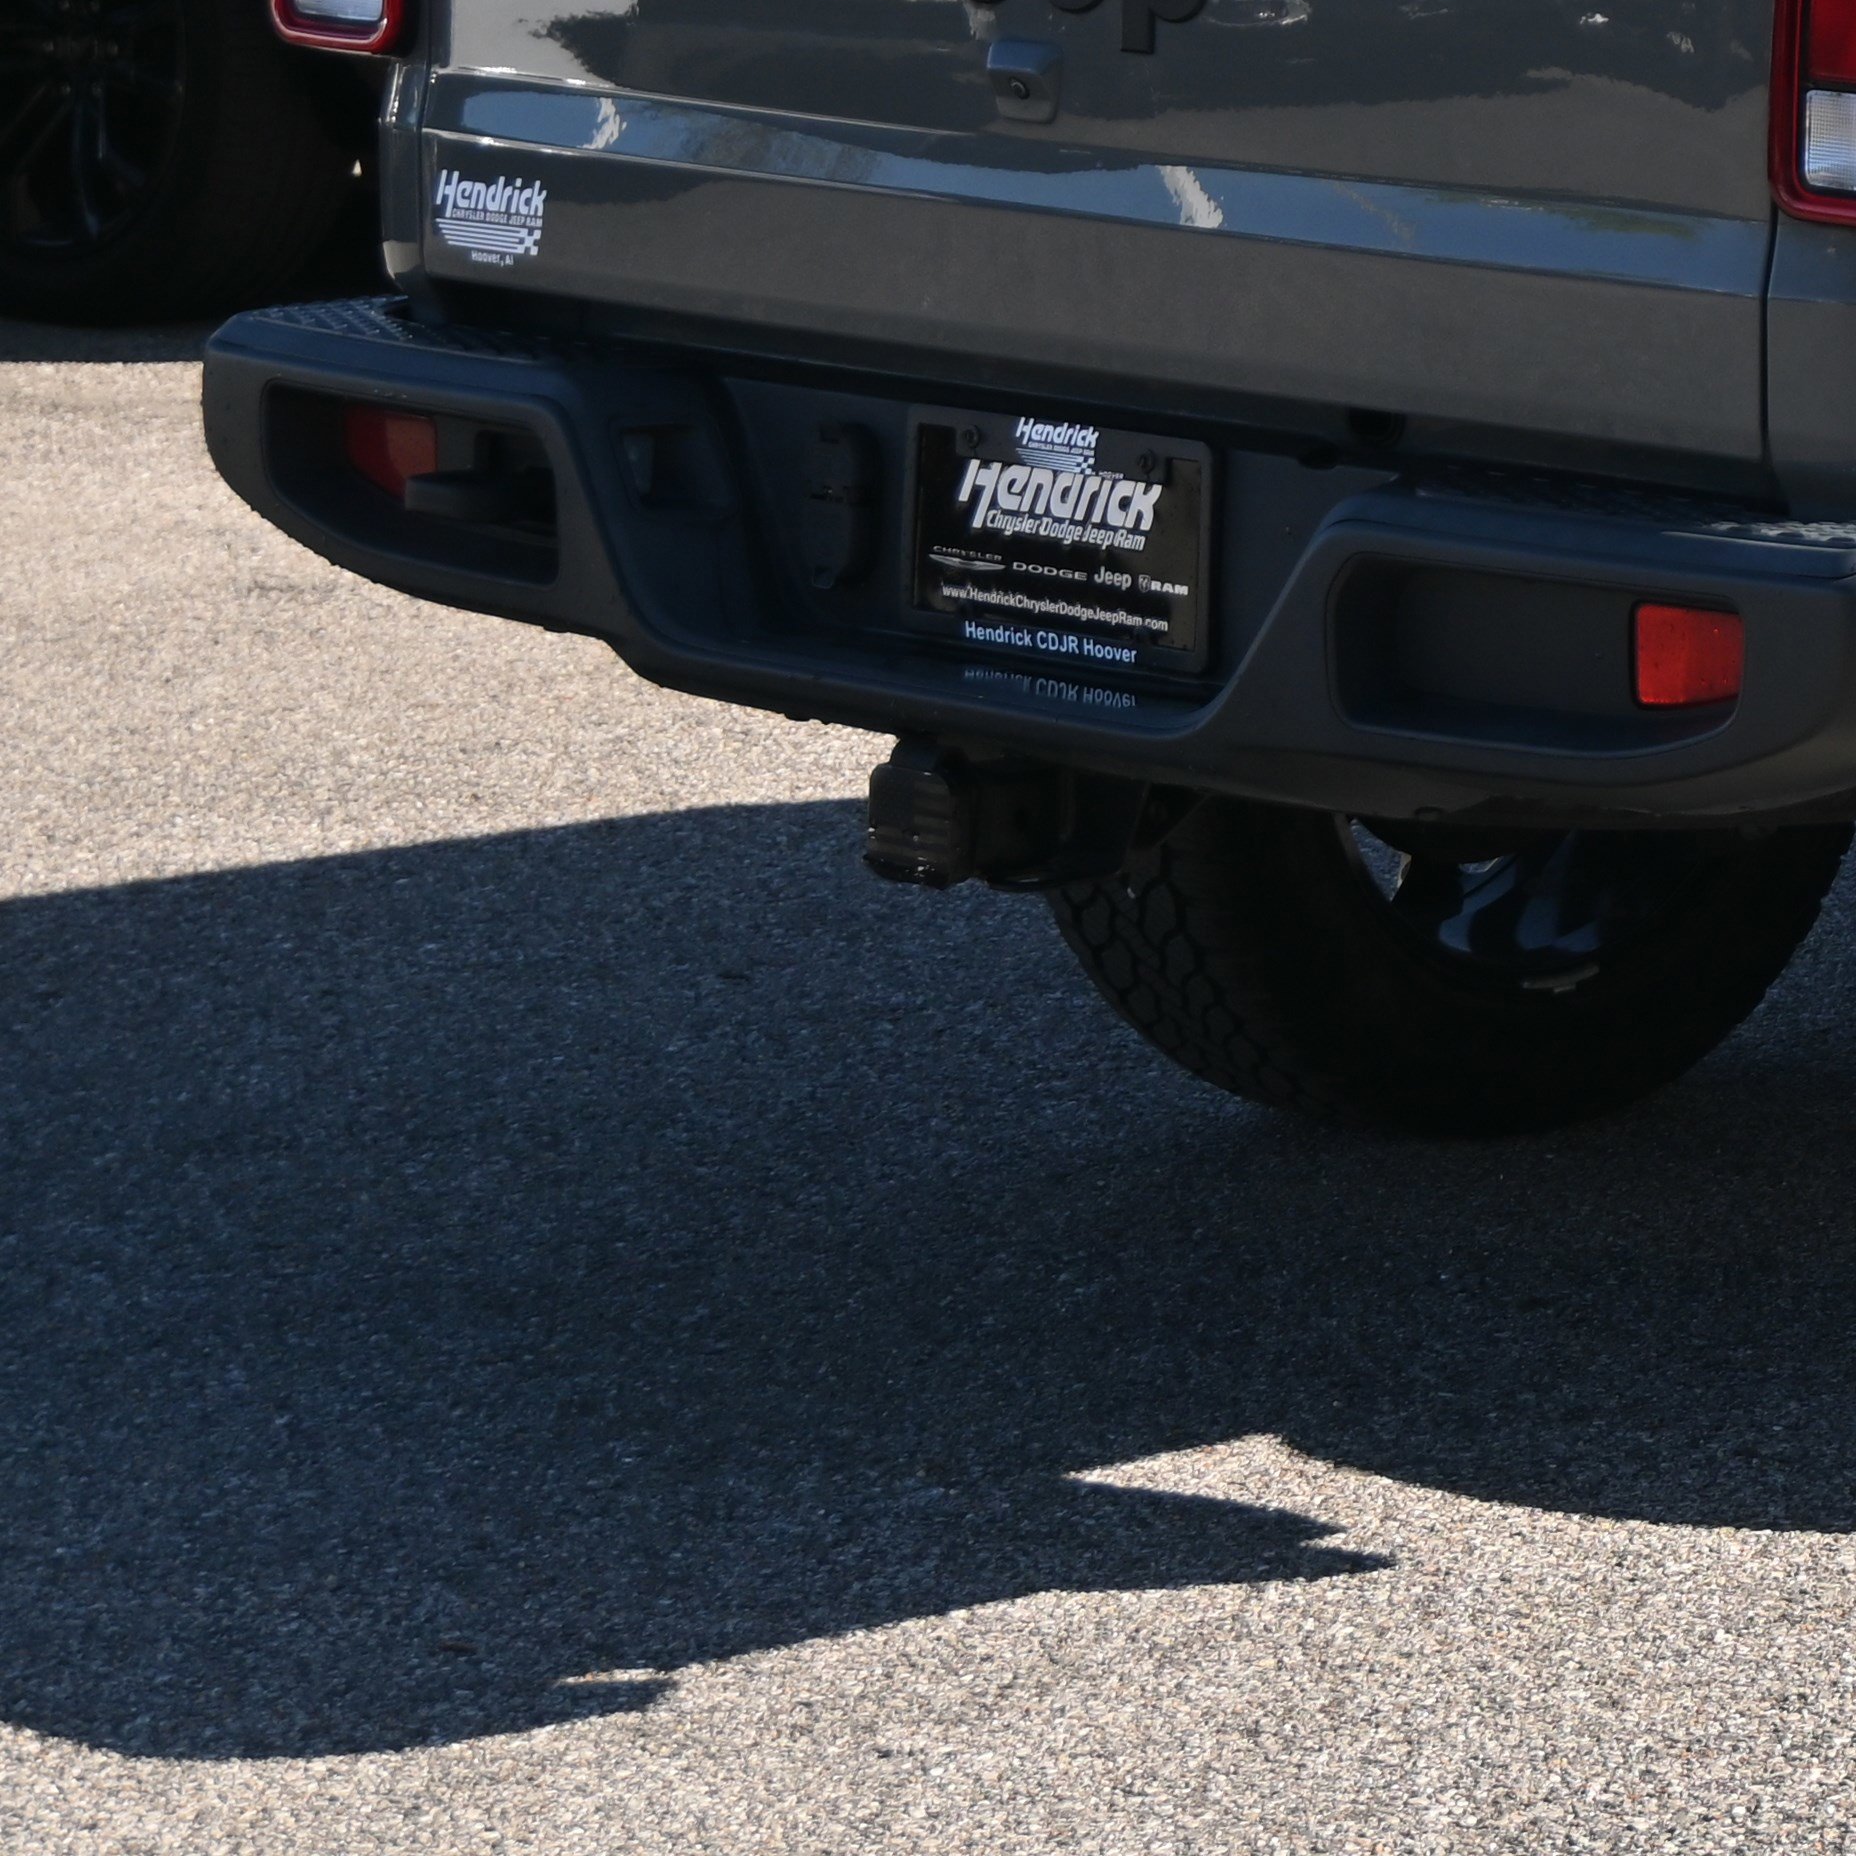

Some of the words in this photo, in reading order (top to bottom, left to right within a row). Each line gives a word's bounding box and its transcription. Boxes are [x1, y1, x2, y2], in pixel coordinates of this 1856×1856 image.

[436, 169, 547, 218] Hendrick
[452, 207, 485, 221] CHRYSLER
[485, 211, 508, 223] DODGE
[508, 215, 525, 225] JEEP
[525, 216, 543, 227] RAM
[471, 250, 504, 267] Hoover,
[1015, 416, 1100, 448] Hendrick
[933, 545, 1002, 561] CHRYSLER
[1012, 561, 1088, 581] DODGE
[1094, 566, 1132, 591] Jeep
[1151, 579, 1189, 596] RAM
[941, 584, 1169, 632] www.HendrickChryslerDodgeJeepRam.com
[964, 620, 1032, 647] Hendrick
[1036, 630, 1079, 654] CDJR
[1083, 635, 1138, 664] Hoover
